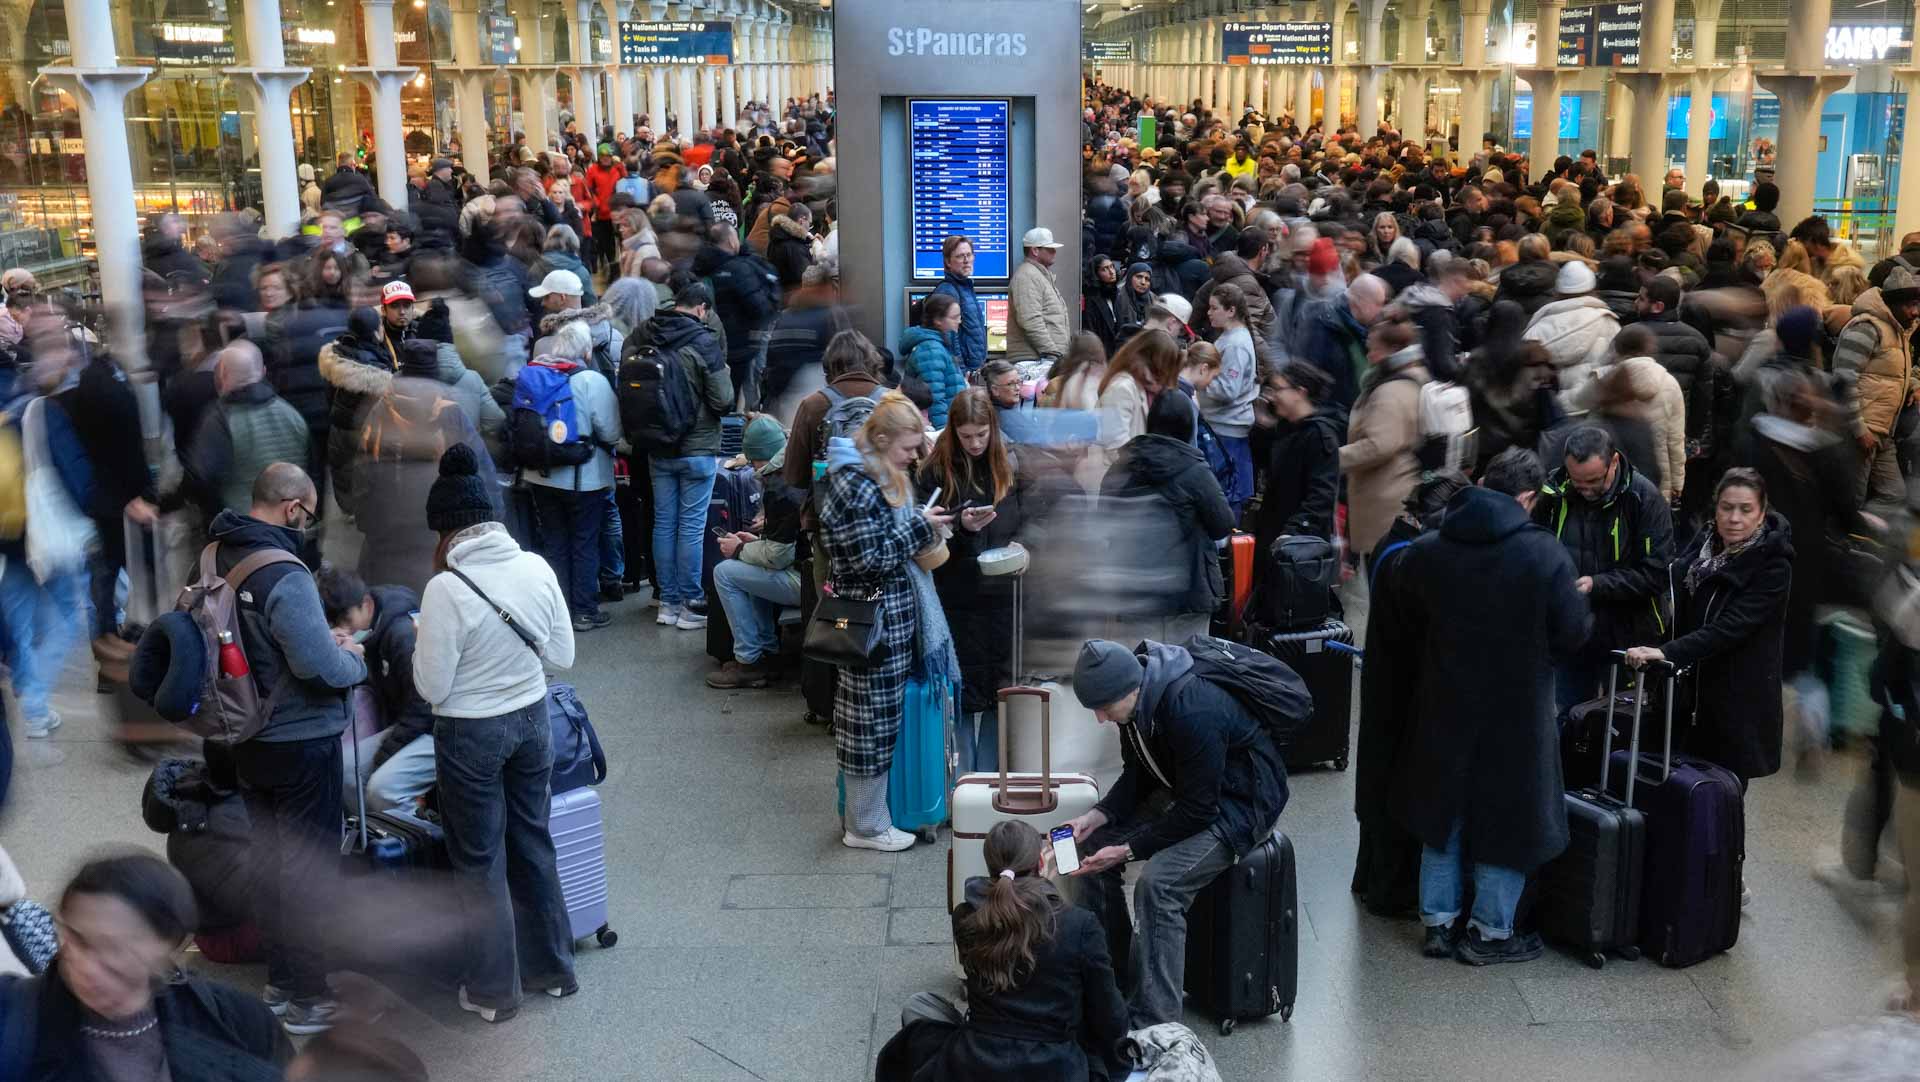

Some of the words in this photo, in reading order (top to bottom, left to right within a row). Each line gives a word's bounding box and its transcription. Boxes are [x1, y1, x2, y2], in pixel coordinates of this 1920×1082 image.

[1262, 23, 1286, 31] Départs
[1287, 23, 1320, 32] Departures
[633, 34, 646, 43] Way
[1282, 34, 1307, 42] National
[1296, 45, 1311, 53] Way
